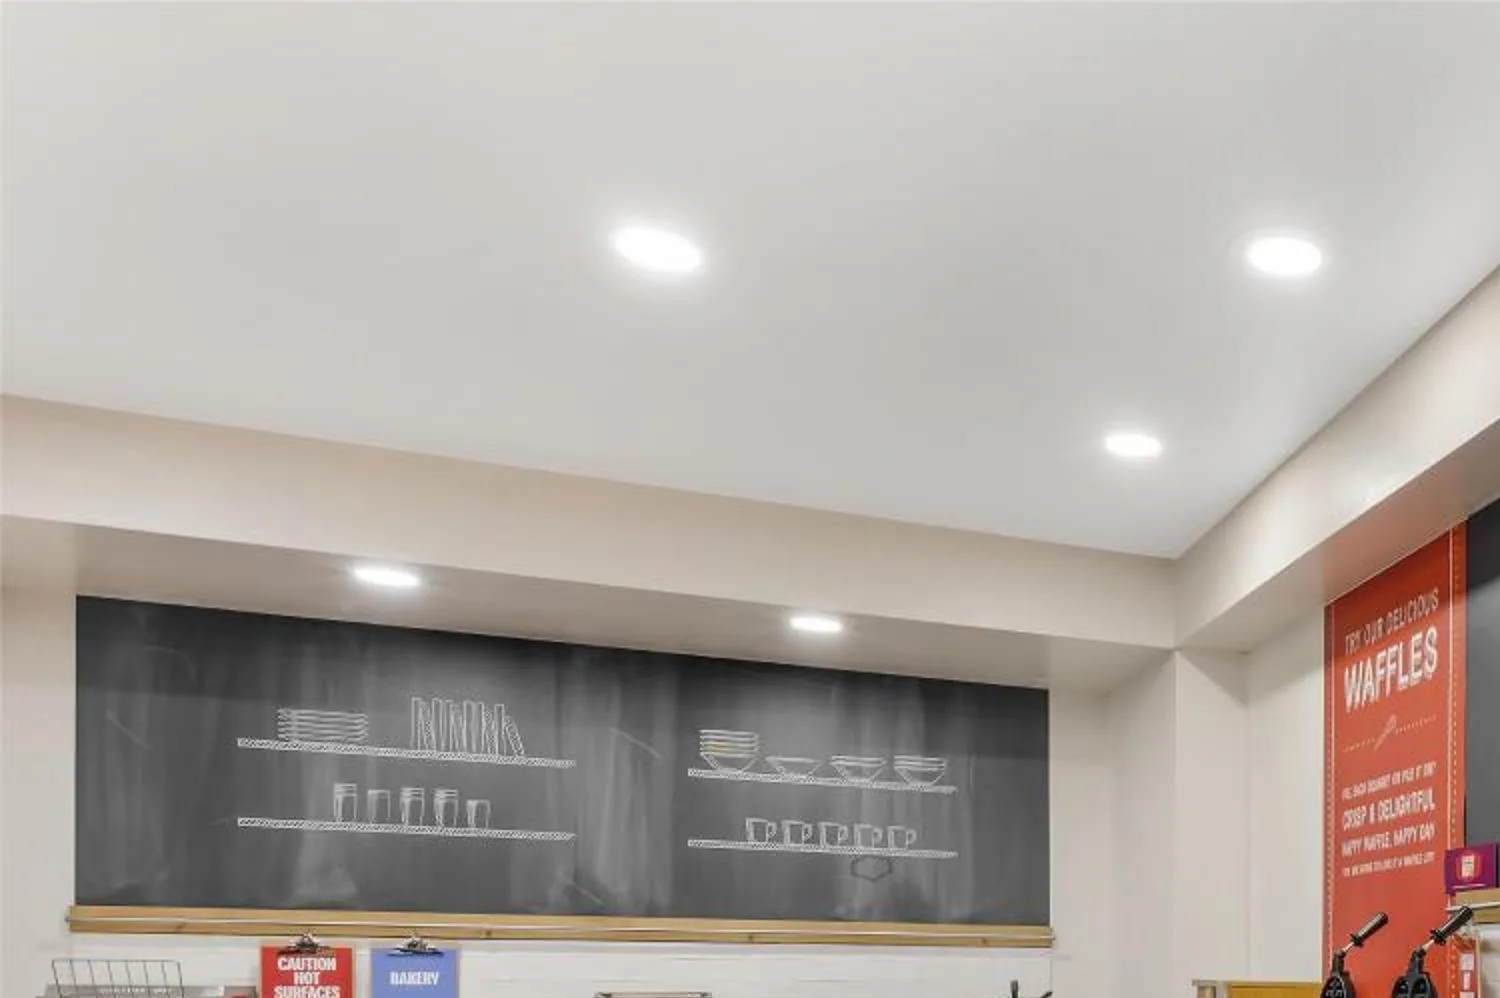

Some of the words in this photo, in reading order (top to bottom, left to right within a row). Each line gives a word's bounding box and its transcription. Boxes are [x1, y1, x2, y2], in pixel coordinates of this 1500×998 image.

[1363, 617, 1384, 646] OUR
[1387, 587, 1440, 635] DELICIOUS
[1343, 625, 1439, 713] WAFFLES
[277, 956, 337, 972] CAUTION
[293, 971, 321, 986] HOT
[390, 970, 440, 986] BAKERY
